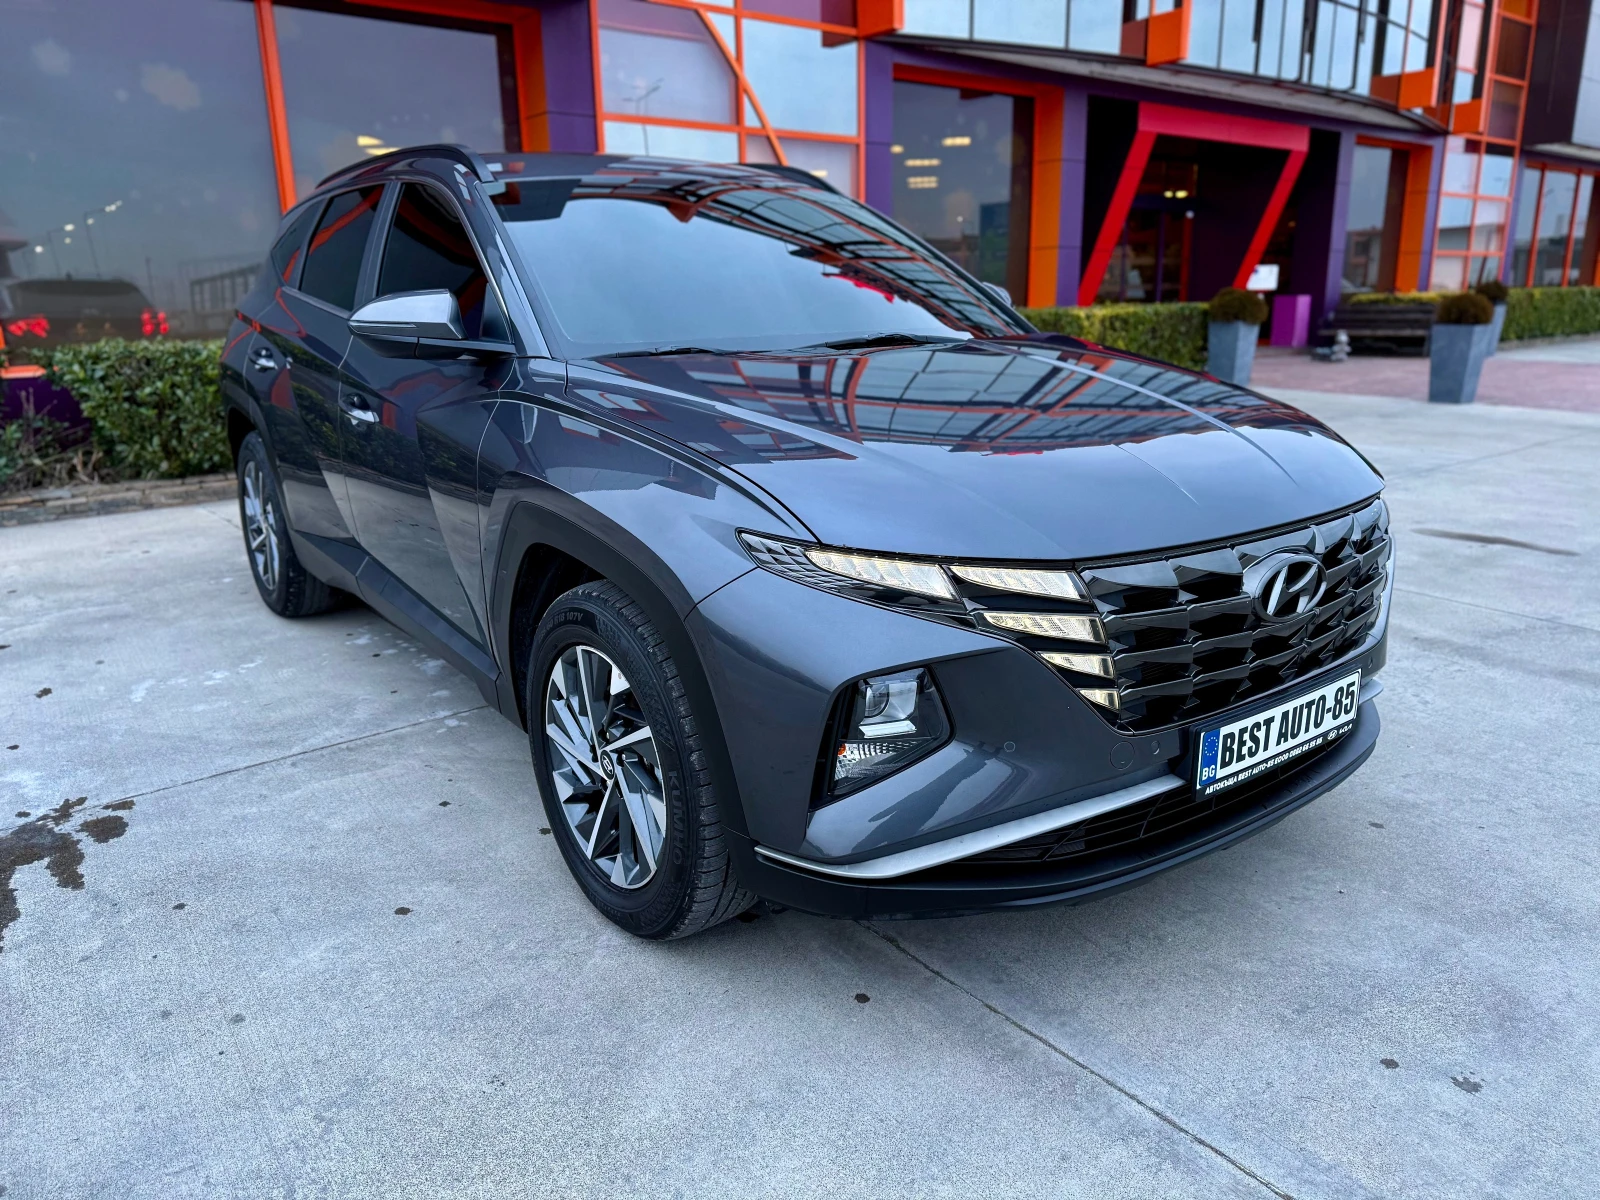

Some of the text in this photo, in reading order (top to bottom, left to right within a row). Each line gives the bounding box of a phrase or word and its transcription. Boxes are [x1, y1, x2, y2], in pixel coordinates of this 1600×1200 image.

[1219, 681, 1356, 770] BEST AUTO-85
[1202, 764, 1216, 781] BG
[1238, 769, 1253, 781] BEST
[668, 771, 686, 865] KUMHO
